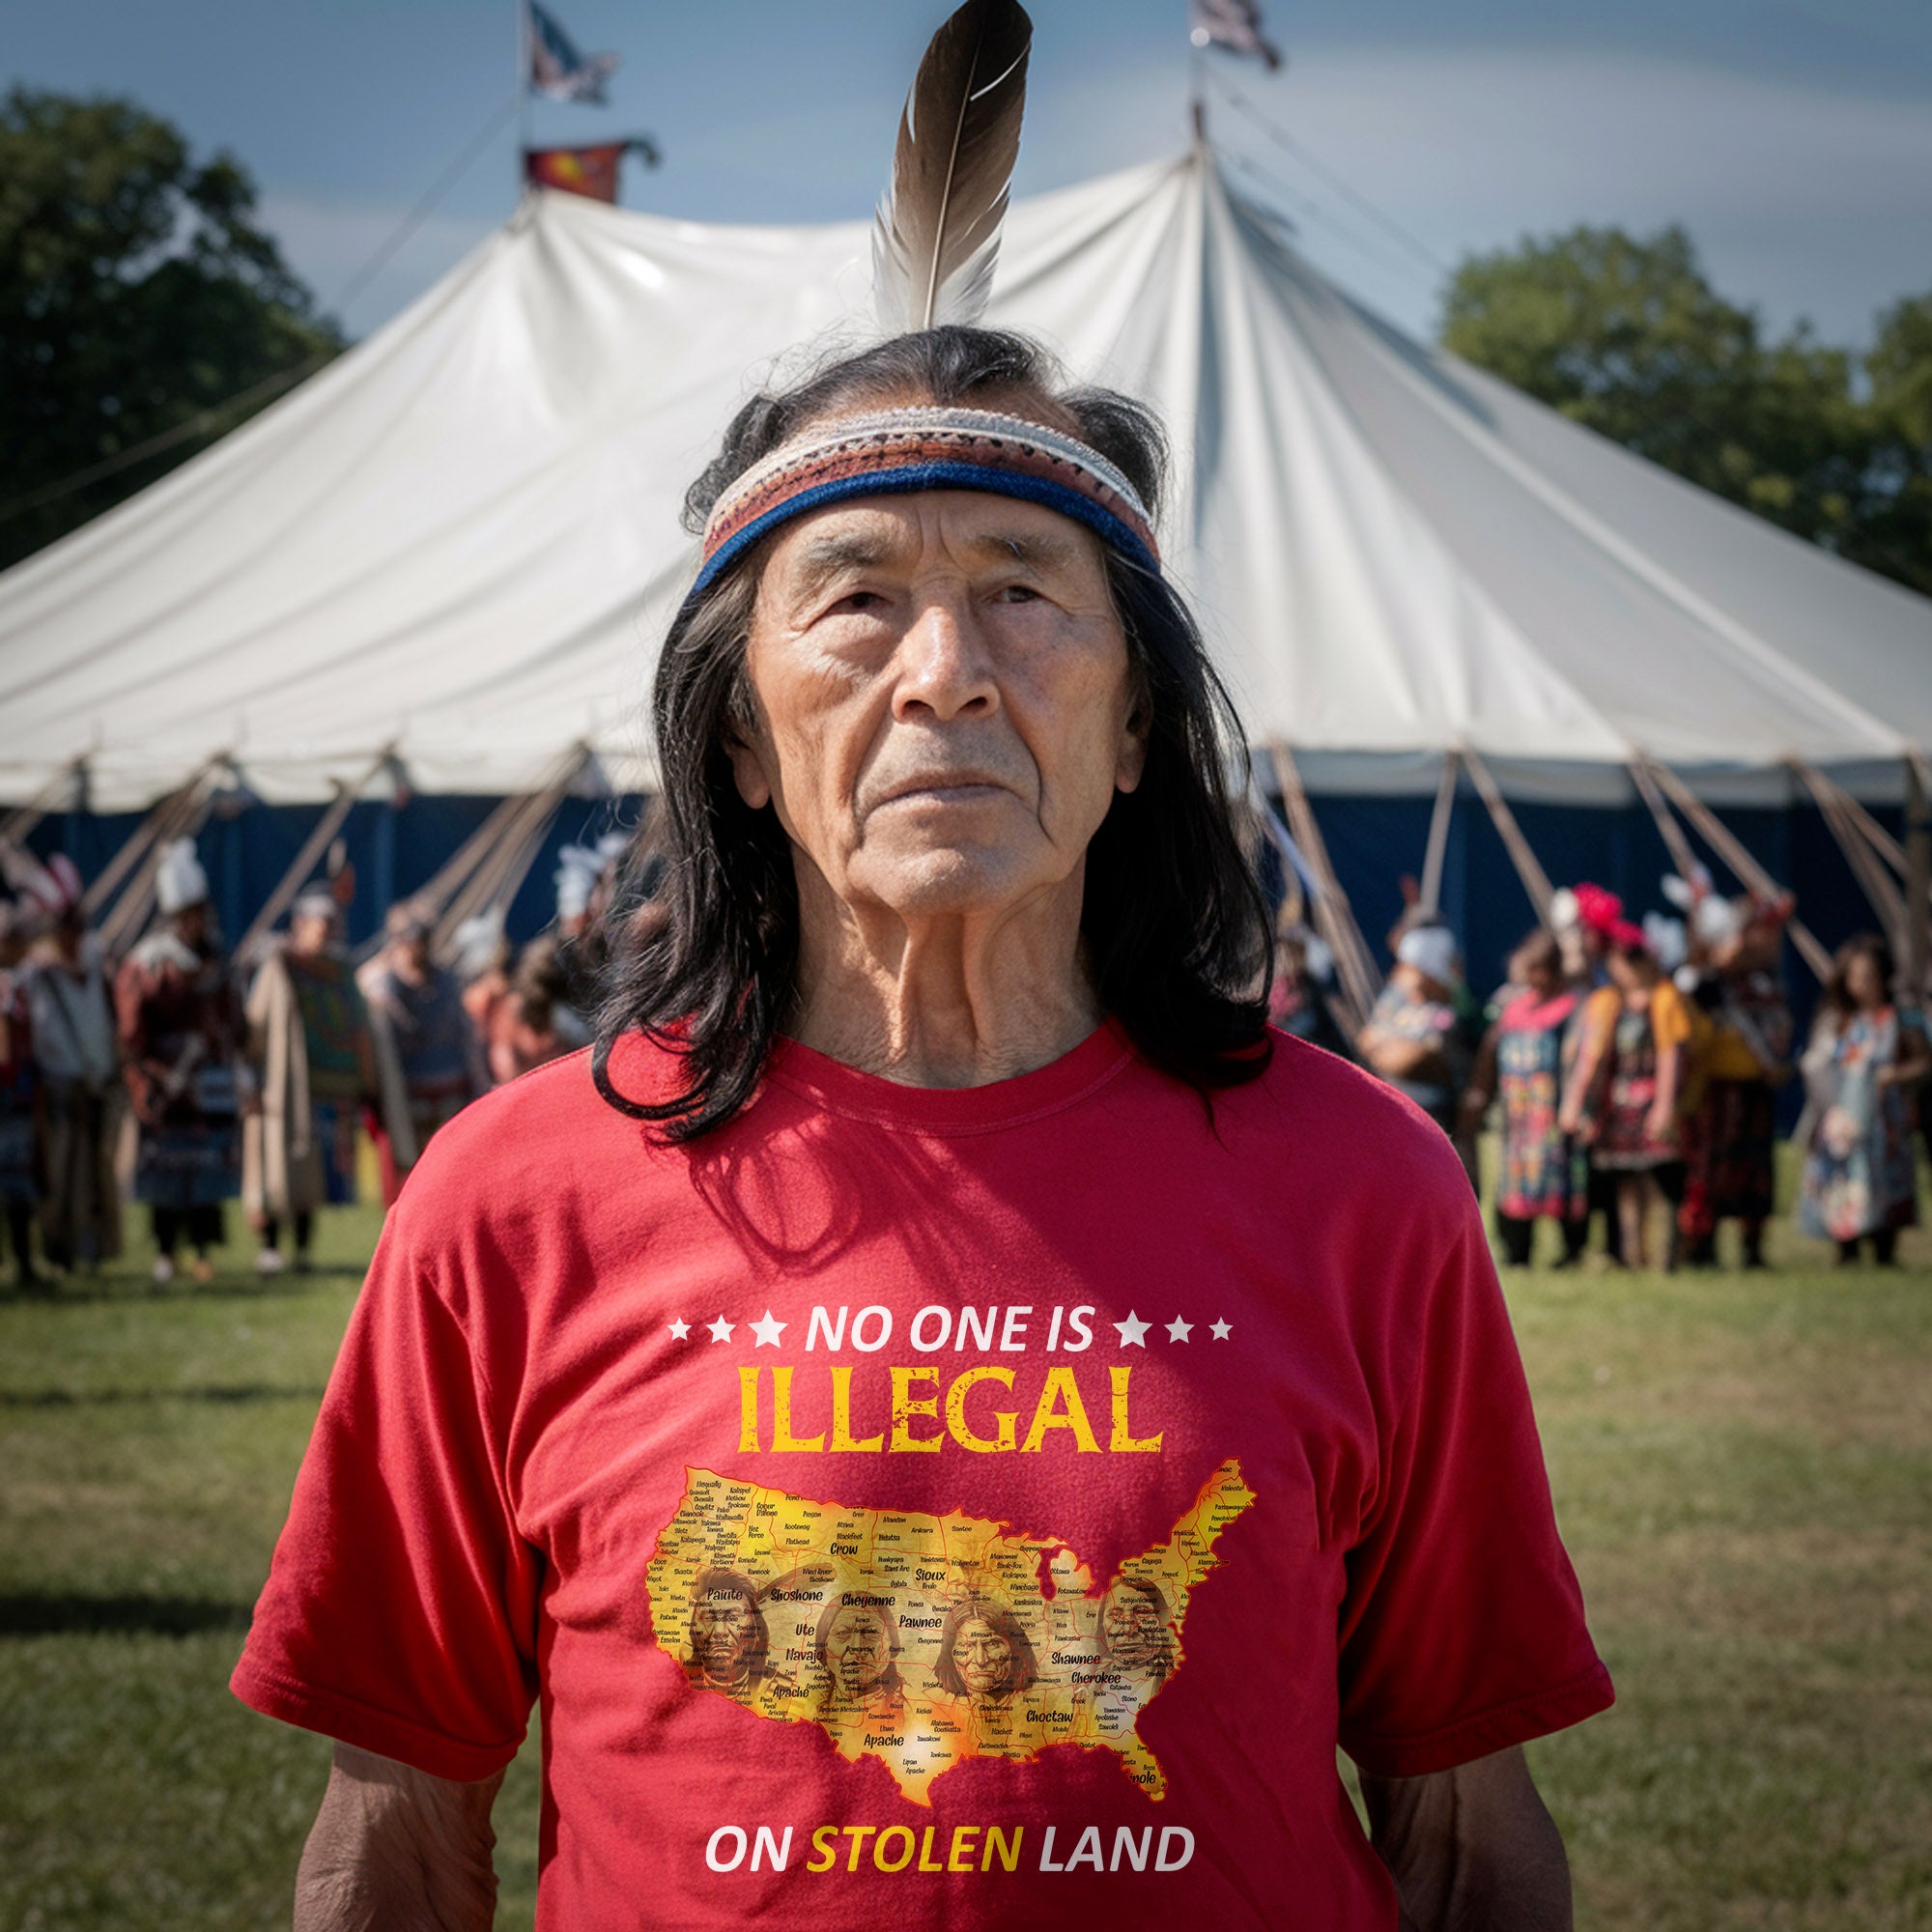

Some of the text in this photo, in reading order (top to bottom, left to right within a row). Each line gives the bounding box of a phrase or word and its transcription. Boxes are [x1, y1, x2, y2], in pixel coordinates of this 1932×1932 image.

[804, 1304, 1096, 1352] NO ONE IS
[736, 1365, 1164, 1454] ILLEGAL
[831, 1543, 858, 1554] Crow
[916, 1569, 946, 1580] Sioux
[707, 1587, 743, 1601] Paiute
[770, 1588, 823, 1602] Shoshone
[841, 1594, 895, 1607] Cheyenne
[899, 1615, 942, 1628] Pawnee
[796, 1624, 814, 1635] Ute
[785, 1648, 823, 1663] Navajo
[1052, 1652, 1100, 1664] Shawnee
[1071, 1672, 1121, 1684] Cherokee
[773, 1684, 810, 1699] Apache
[1026, 1710, 1074, 1722] Choctaw
[864, 1734, 904, 1748] Apache
[1130, 1771, 1155, 1783] inole
[705, 1824, 1196, 1873] ON STOLEN LAND
